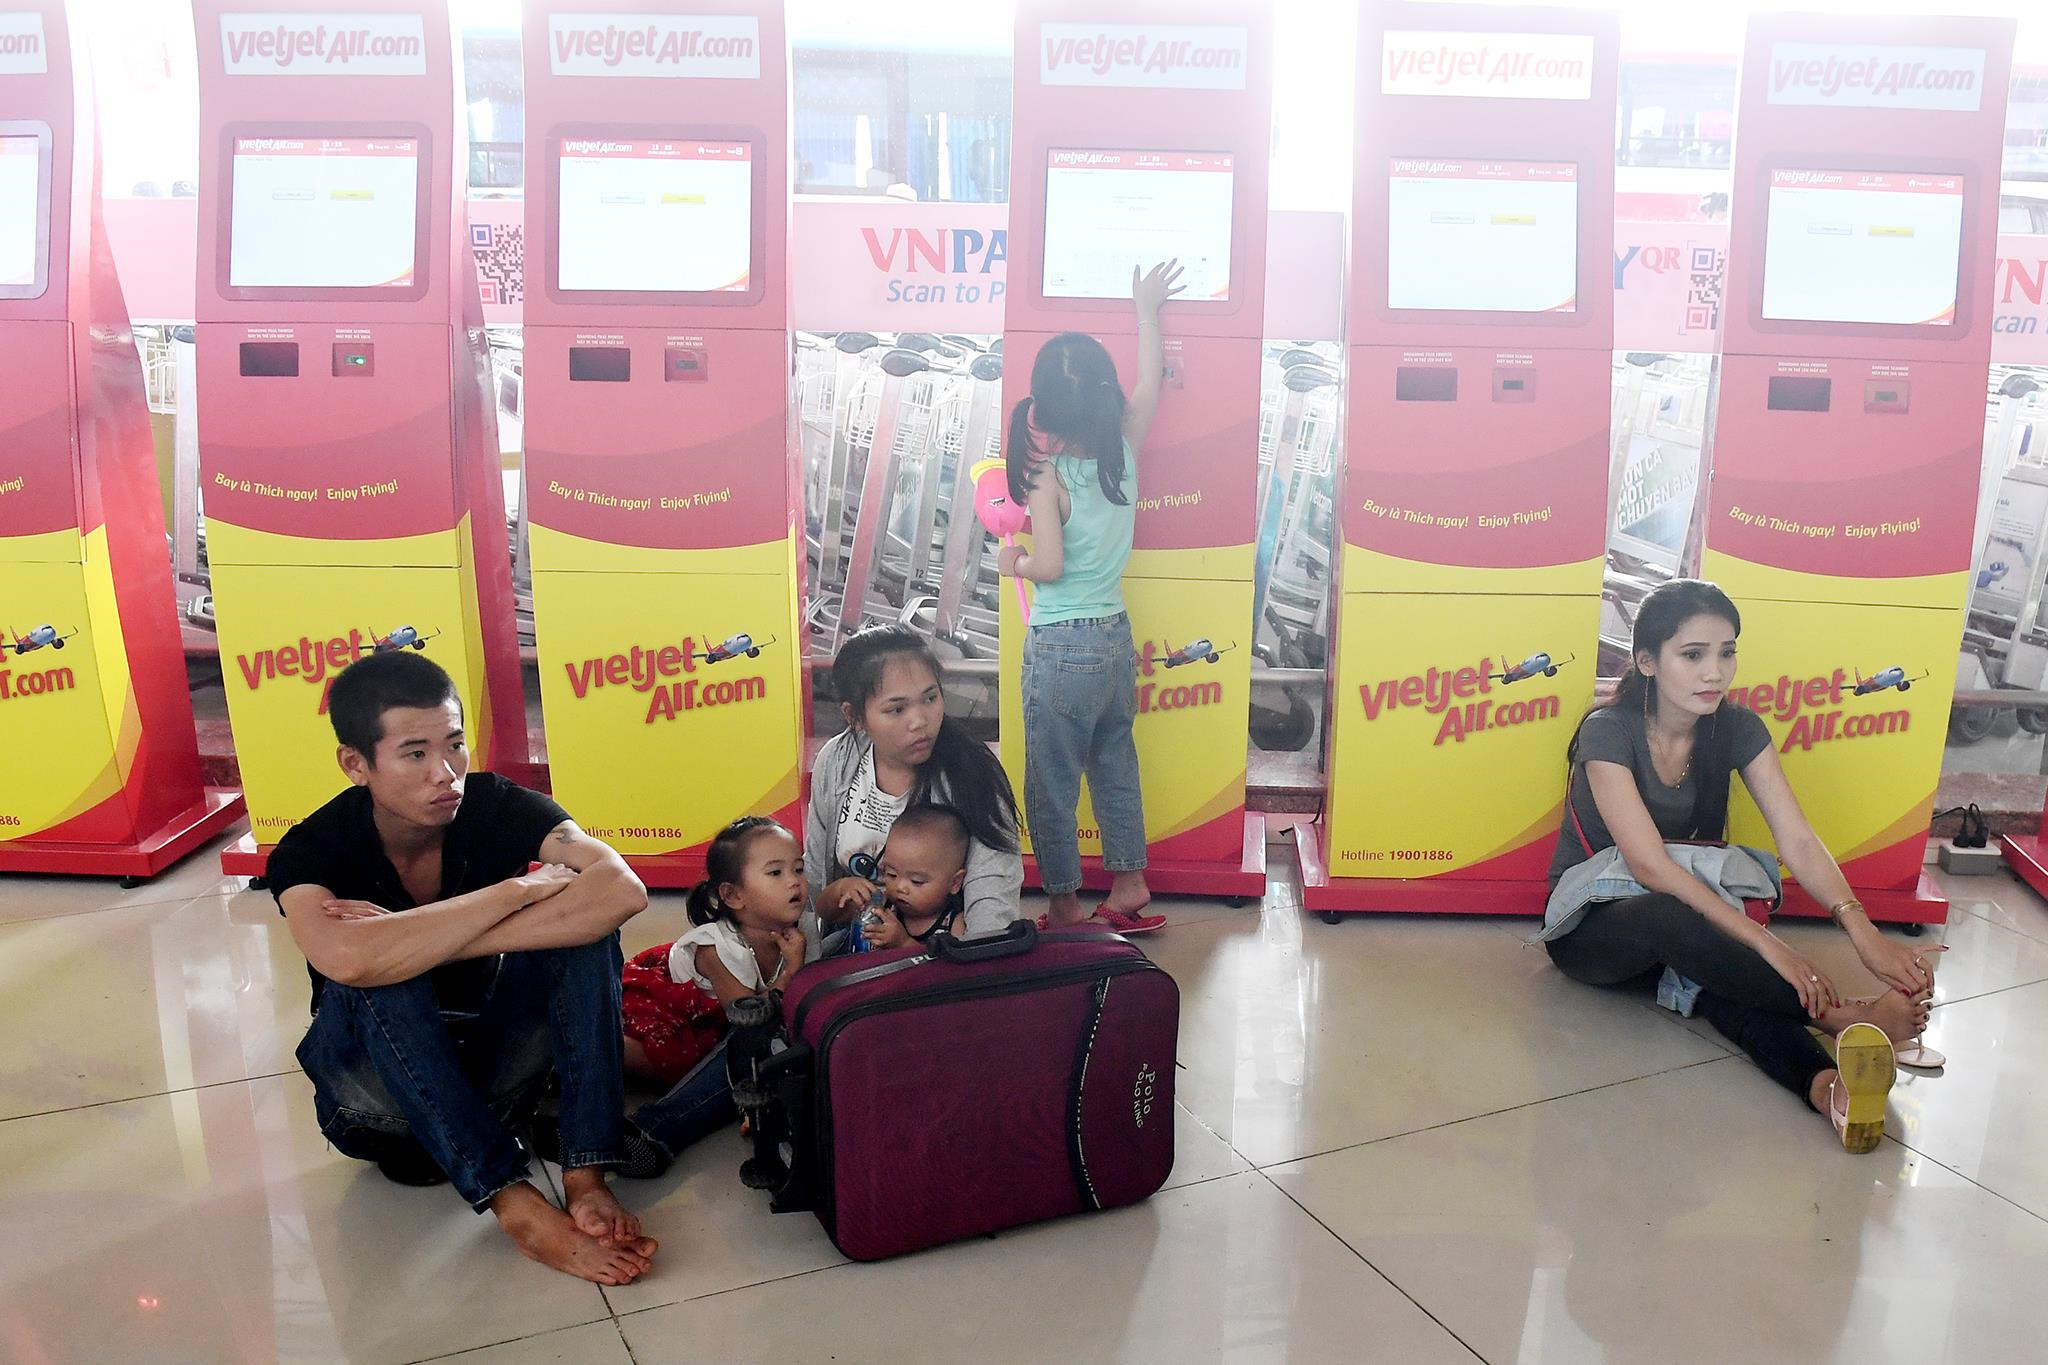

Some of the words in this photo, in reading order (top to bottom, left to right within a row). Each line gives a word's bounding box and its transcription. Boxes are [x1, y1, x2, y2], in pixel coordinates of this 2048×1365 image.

[860, 227, 1007, 274] VNPA
[886, 280, 946, 303] Scan
[955, 282, 980, 303] to
[1993, 315, 2037, 334] can
[0, 476, 24, 495] ying!
[215, 472, 238, 490] Bay
[240, 481, 251, 493] là
[254, 482, 284, 498] Thích
[286, 489, 318, 502] ngay!
[327, 488, 358, 501] Enjoy
[360, 479, 398, 498] Flying!
[548, 480, 573, 500] Bay
[574, 488, 585, 501] là
[587, 491, 617, 507] Thích
[619, 498, 651, 511] ngay!
[660, 497, 691, 511] Enjoy
[693, 487, 731, 507] Flying!
[1136, 498, 1161, 511] njoy
[1163, 490, 1202, 507] Flying!
[1363, 499, 1387, 517] Bay
[1389, 507, 1401, 520] là
[1403, 510, 1434, 525] Thích
[1436, 516, 1469, 529] ngay!
[1478, 515, 1511, 528] Enjoy
[1512, 506, 1552, 525] Flying!
[1729, 506, 1753, 525] Bay
[1755, 515, 1767, 527] là
[1769, 517, 1800, 534] Thích
[1802, 526, 1836, 539] ngay!
[1845, 525, 1878, 539] Enjoy
[1880, 517, 1921, 536] Flying!
[0, 667, 74, 699] r.com
[1134, 682, 1221, 713] r.com
[645, 676, 765, 724] Air.com
[1433, 695, 1560, 745] Air.com
[1780, 709, 1910, 753] Air.com
[582, 826, 614, 838] tline
[619, 827, 682, 838] 19001886
[1341, 849, 1384, 861] Hotline
[1389, 850, 1453, 860] 19001886
[1143, 1070, 1156, 1114] Polo
[1133, 1099, 1144, 1129] KING
